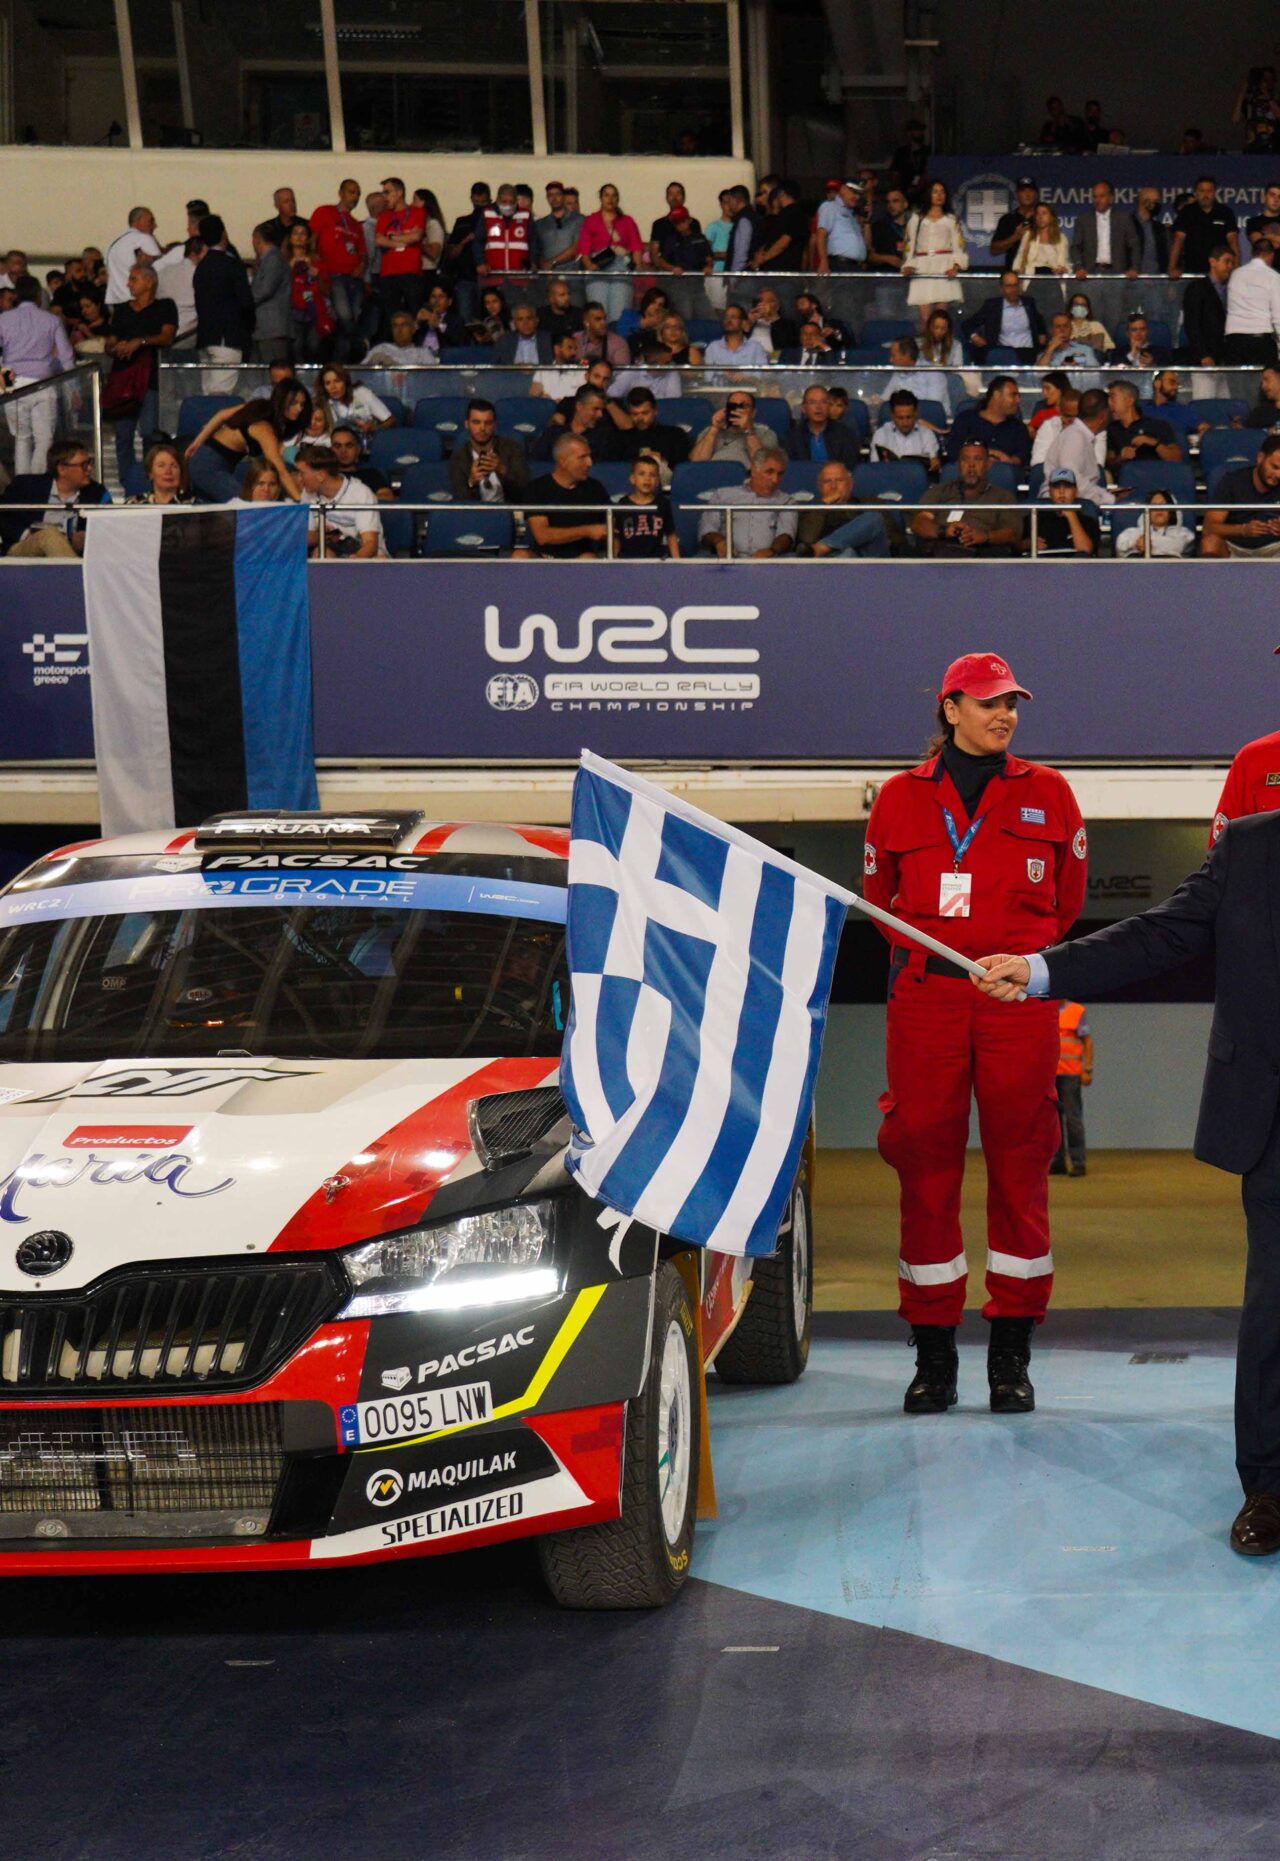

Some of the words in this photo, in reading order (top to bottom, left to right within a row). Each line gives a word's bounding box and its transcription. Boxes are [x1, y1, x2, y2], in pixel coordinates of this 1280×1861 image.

[485, 605, 760, 662] WRC
[34, 675, 69, 687] greece
[551, 681, 583, 692] FIA
[591, 681, 670, 692] WORLD
[677, 681, 753, 692] RALLY
[551, 702, 754, 711] CHAMPIONSHIP
[205, 854, 430, 870] PACSAC
[239, 877, 418, 896] GRADE
[274, 893, 411, 903] DIGITAL
[8, 898, 62, 915] WRC2
[70, 1134, 179, 1147] Productos
[417, 1325, 535, 1384] PACSAC
[364, 1395, 433, 1439] 0095
[440, 1385, 488, 1426] LNW
[346, 1429, 355, 1441] E
[407, 1451, 517, 1492] MAQUILAK
[381, 1491, 524, 1546] SPECIALIZED
